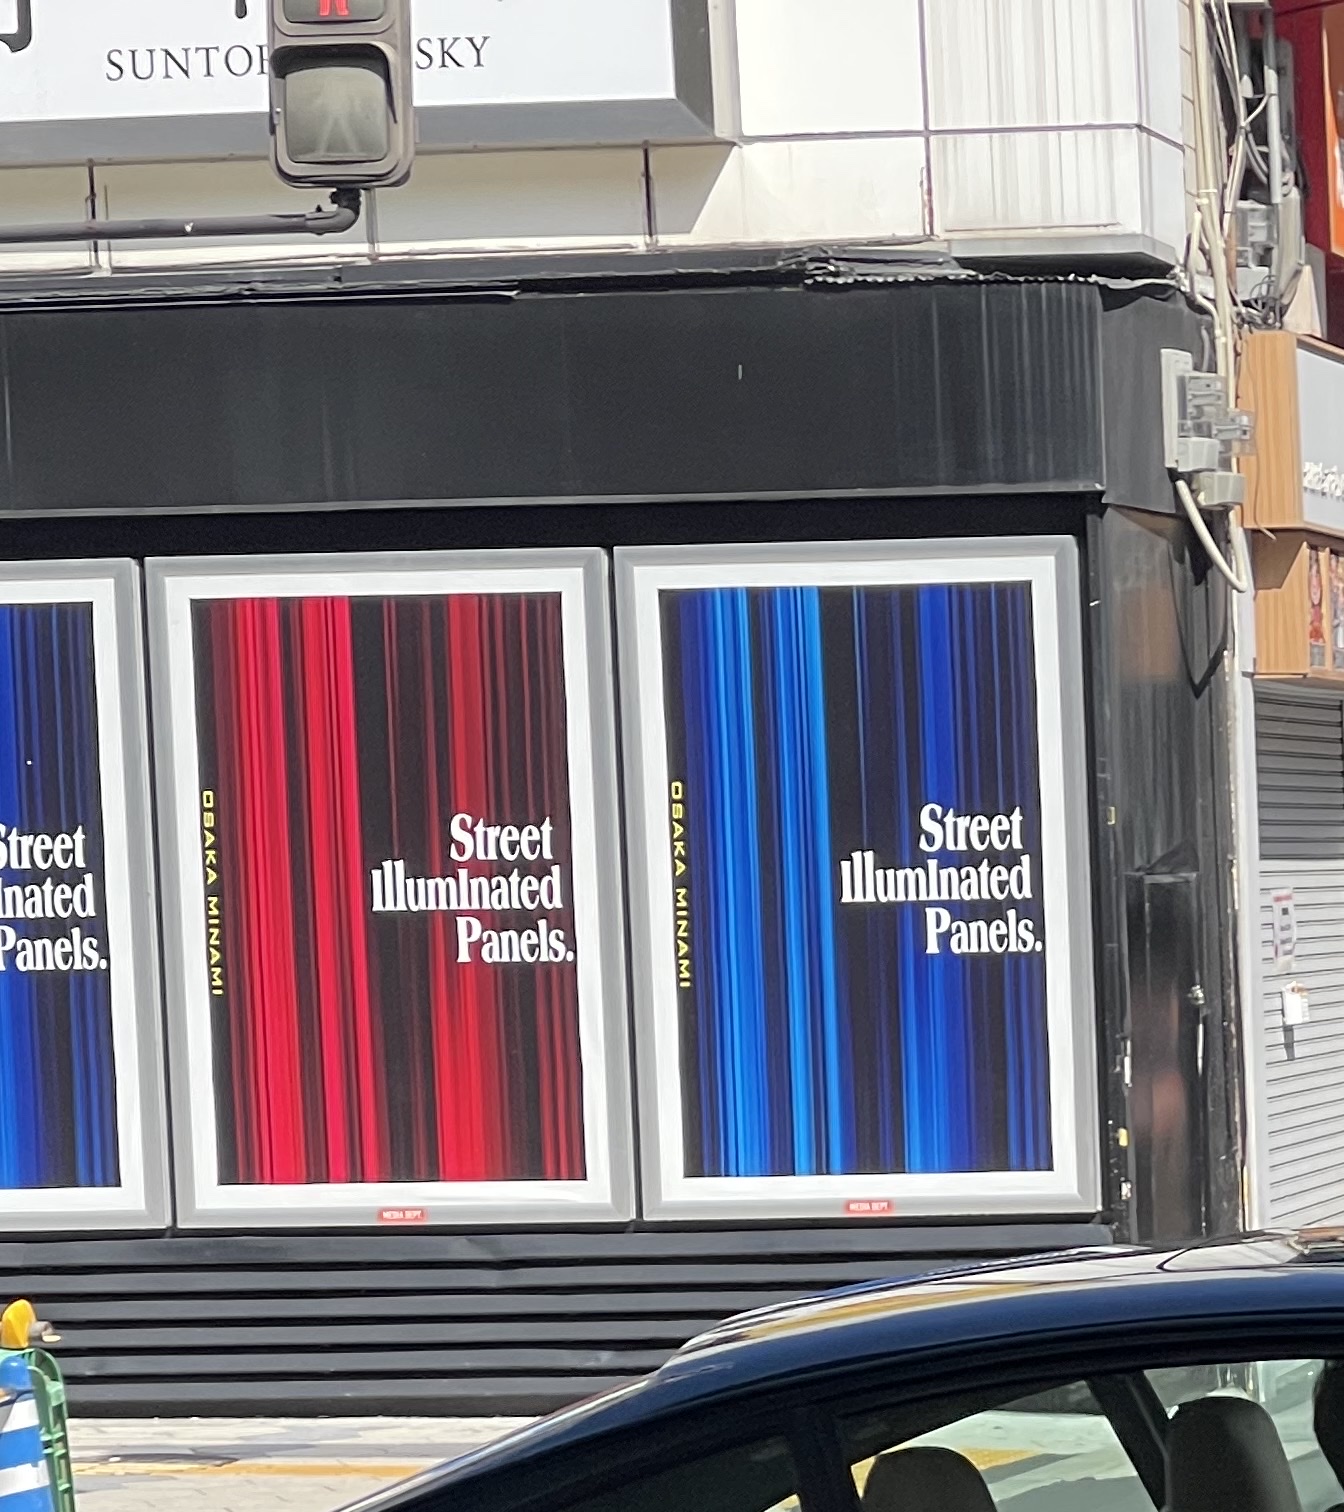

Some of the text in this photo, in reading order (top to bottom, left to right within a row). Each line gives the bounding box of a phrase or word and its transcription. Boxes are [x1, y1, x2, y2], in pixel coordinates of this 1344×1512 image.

[105, 36, 491, 81] SUNTO SKY
[449, 813, 553, 862] Street
[919, 803, 1023, 852] Street
[202, 790, 223, 995] OSAKA MINAMI
[671, 781, 691, 988] OSAKA MINAMI
[456, 916, 574, 963] Panels.
[925, 907, 1043, 954] Panels.
